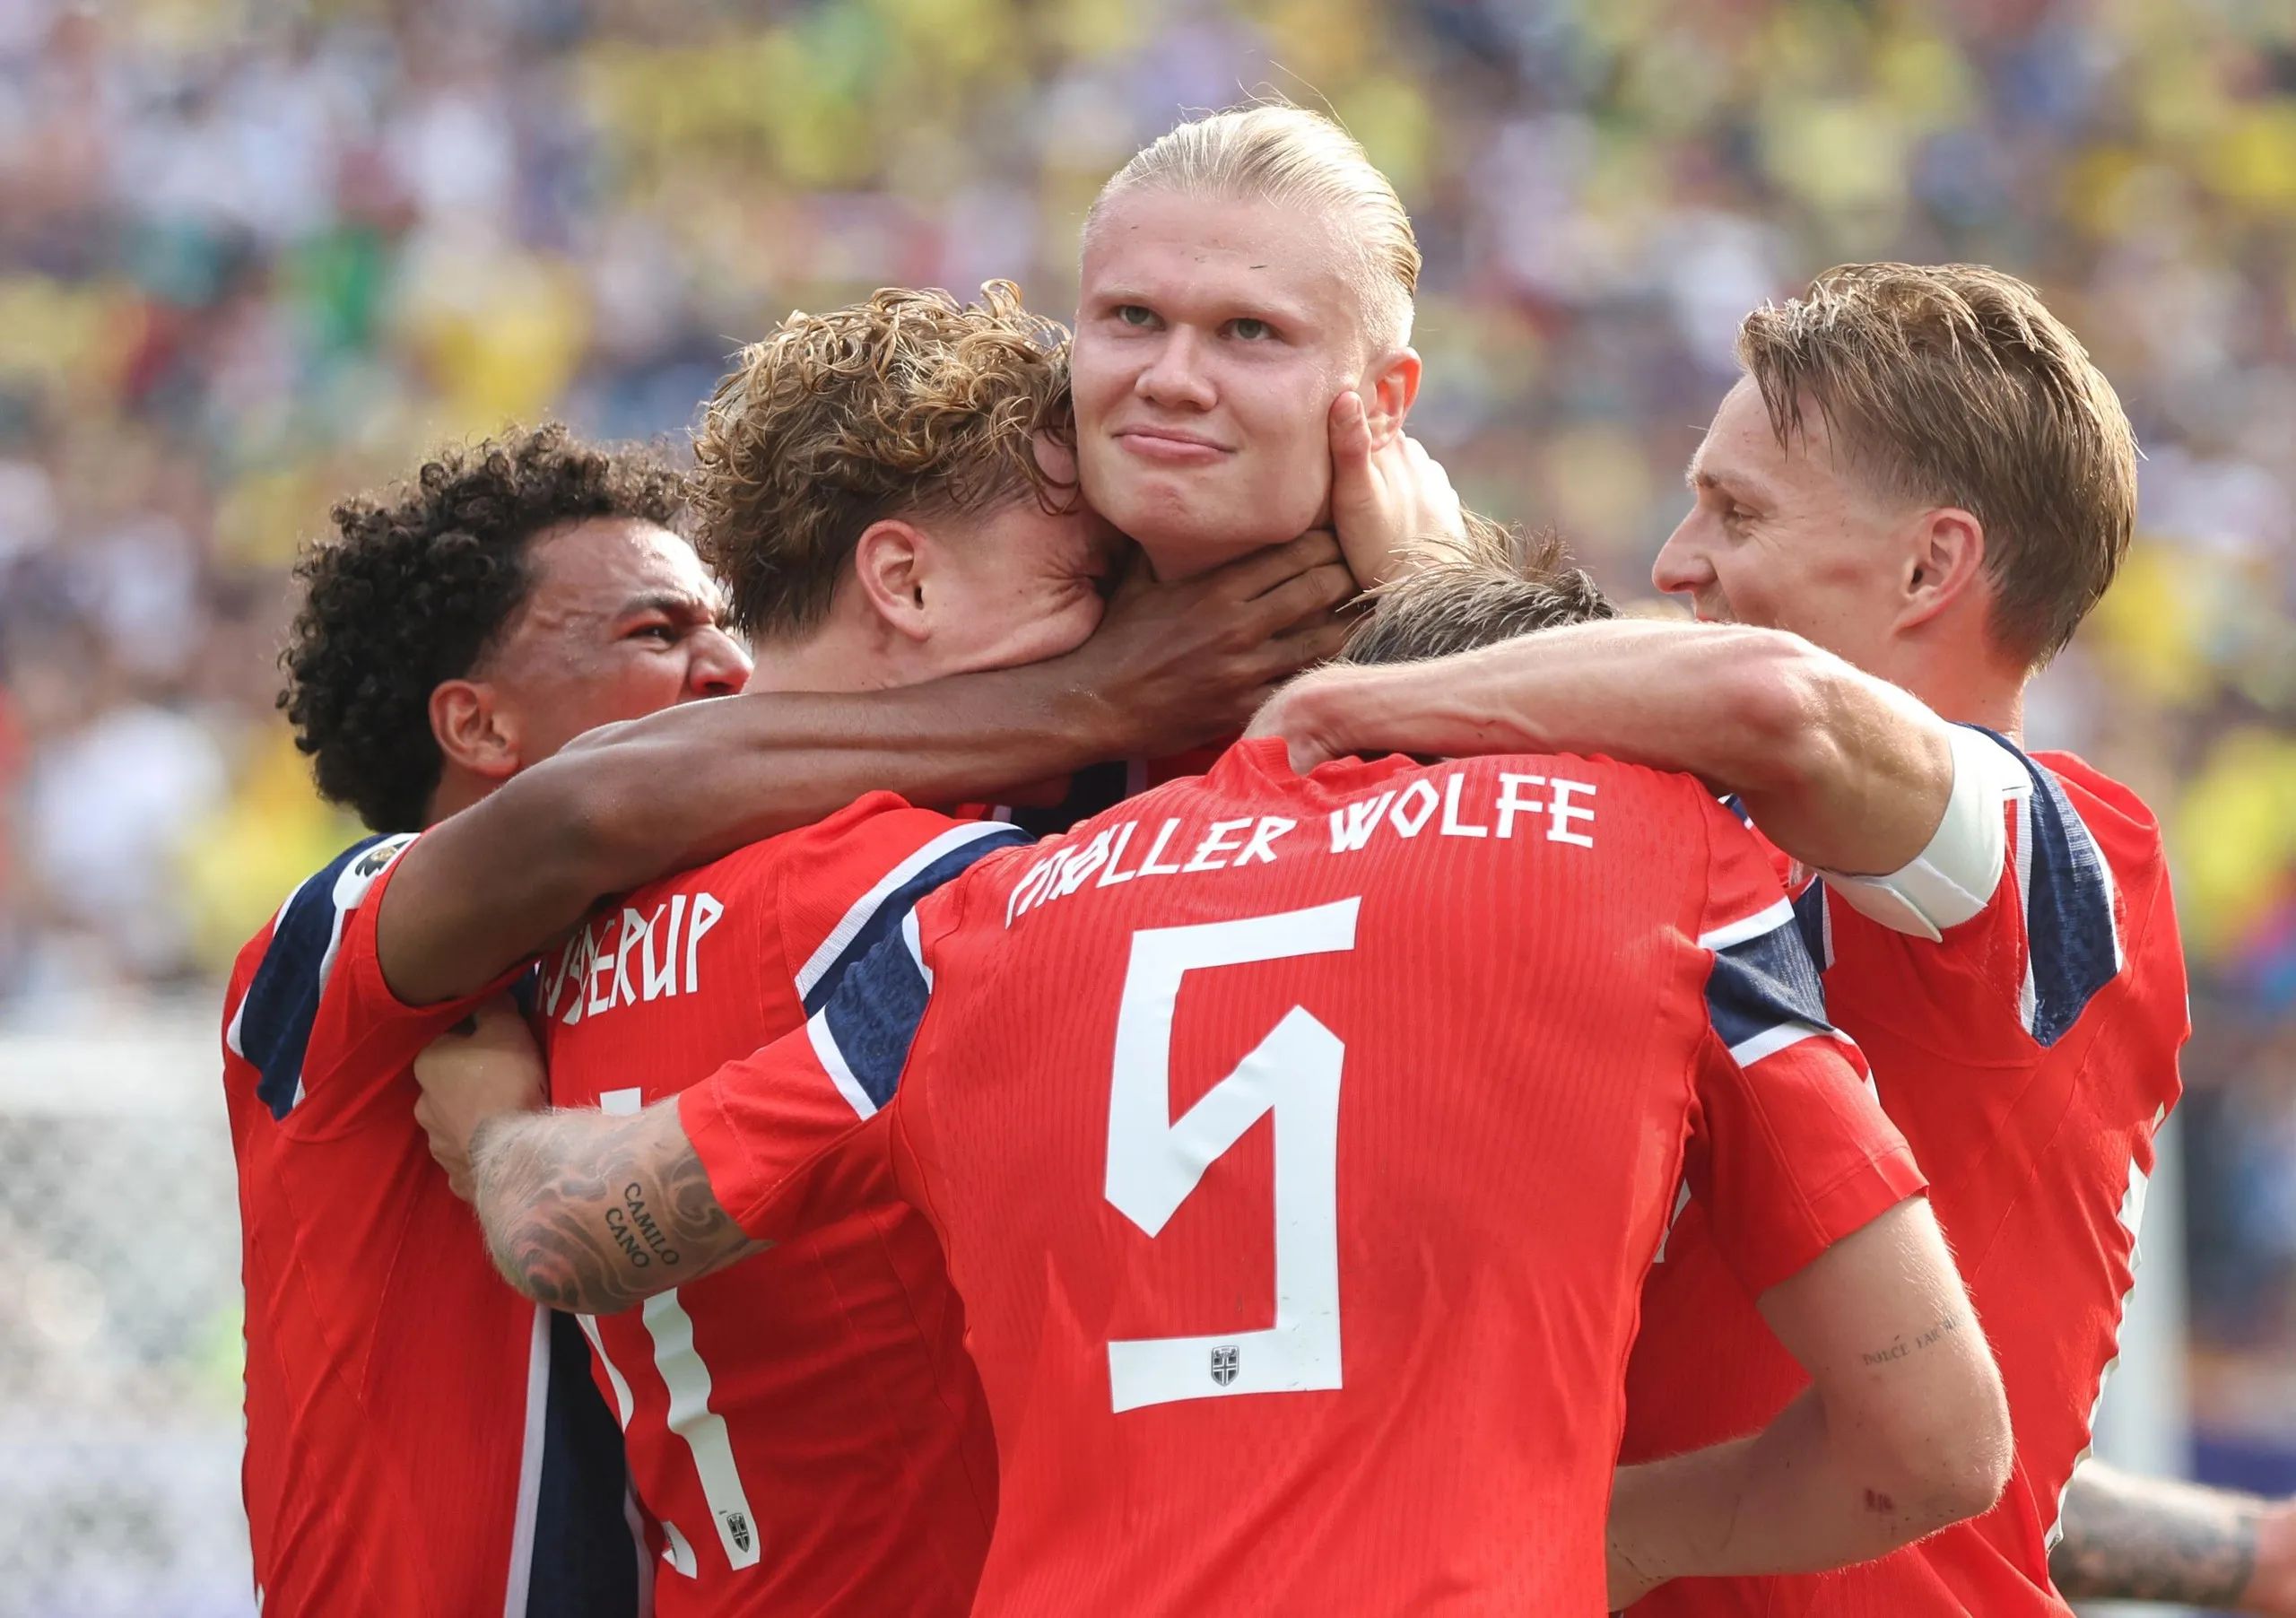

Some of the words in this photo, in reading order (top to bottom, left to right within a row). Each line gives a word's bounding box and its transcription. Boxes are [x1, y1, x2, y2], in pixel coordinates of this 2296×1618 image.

[1005, 815, 1298, 929] MØLLER
[1328, 771, 1596, 849] WOLFE
[1105, 896, 1361, 1414] 5
[605, 1207, 650, 1268] CANO
[624, 1182, 680, 1266] CAMILO
